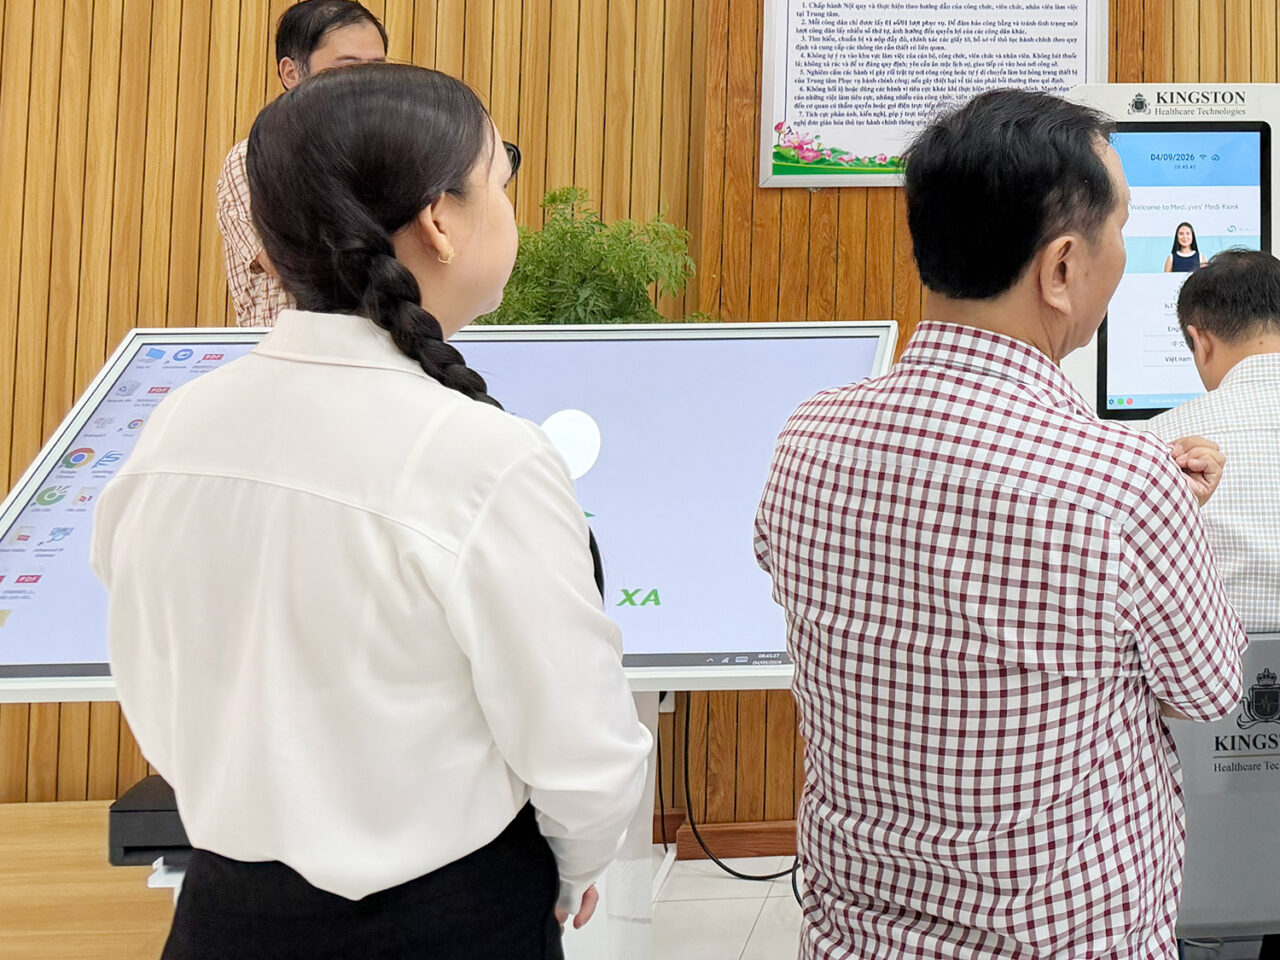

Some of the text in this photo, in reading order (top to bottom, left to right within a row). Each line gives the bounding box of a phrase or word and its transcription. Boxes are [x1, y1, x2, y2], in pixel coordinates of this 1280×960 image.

[1156, 91, 1246, 104] KINGSTON
[1155, 107, 1246, 117] Healthcare Technologies
[1150, 153, 1195, 161] 04/09/2026
[616, 588, 661, 606] XA
[1213, 762, 1261, 772] Healthcare
